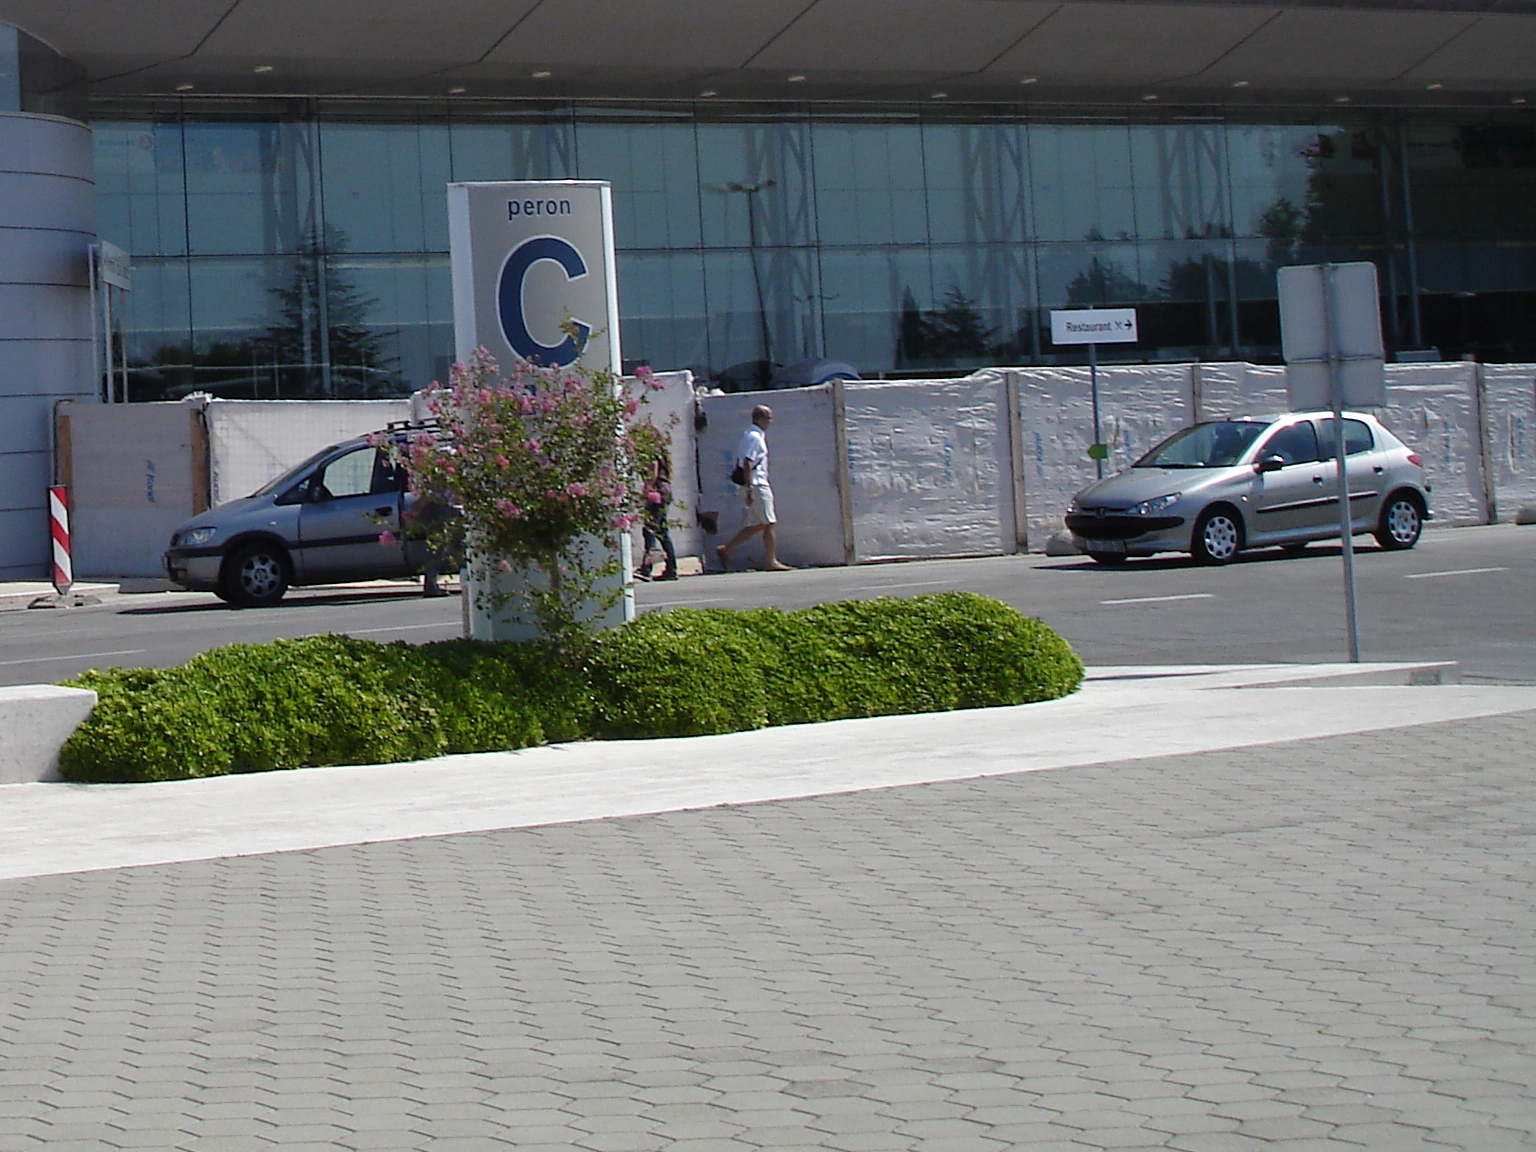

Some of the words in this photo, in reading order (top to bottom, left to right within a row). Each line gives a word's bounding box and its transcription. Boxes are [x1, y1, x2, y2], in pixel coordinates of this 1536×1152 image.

[508, 198, 571, 221] peron
[497, 235, 591, 369] C
[1066, 321, 1112, 333] Restaurant
